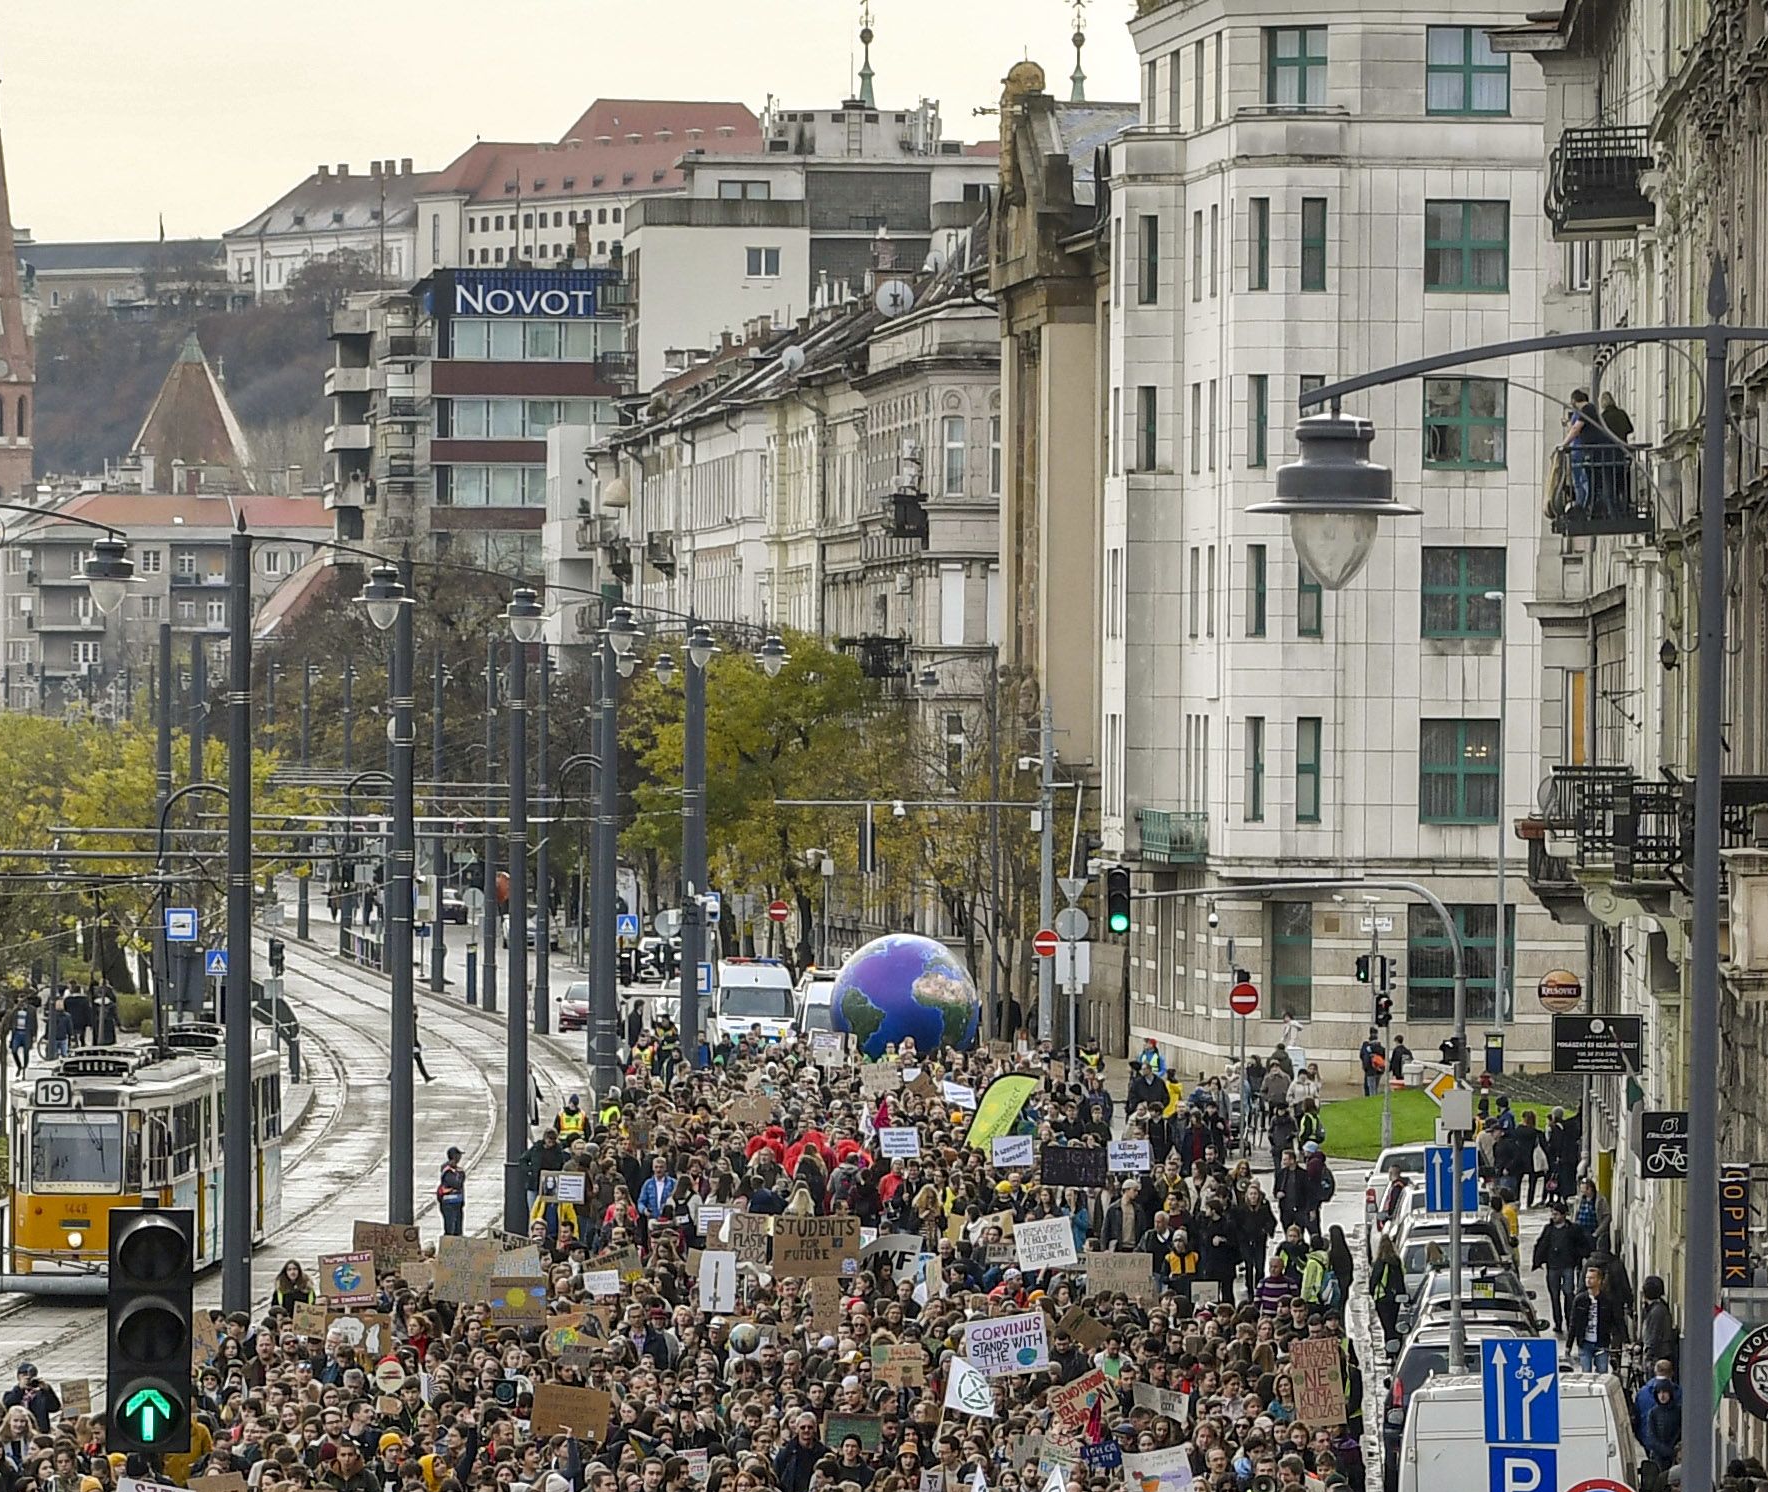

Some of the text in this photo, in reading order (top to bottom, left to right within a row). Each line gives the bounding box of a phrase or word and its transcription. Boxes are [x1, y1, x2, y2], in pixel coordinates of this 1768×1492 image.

[40, 1084, 64, 1103] 19
[733, 1215, 764, 1232] STOP
[776, 1218, 855, 1238] STUDENTS
[1723, 1185, 1747, 1281] OPTIK
[800, 1238, 819, 1249] FOR
[783, 1249, 830, 1261] FUTURE
[971, 1316, 1042, 1342] CORVINUS
[972, 1332, 1043, 1357] STANDS WITH
[979, 1351, 1010, 1366] THE
[1303, 1367, 1327, 1388] NE
